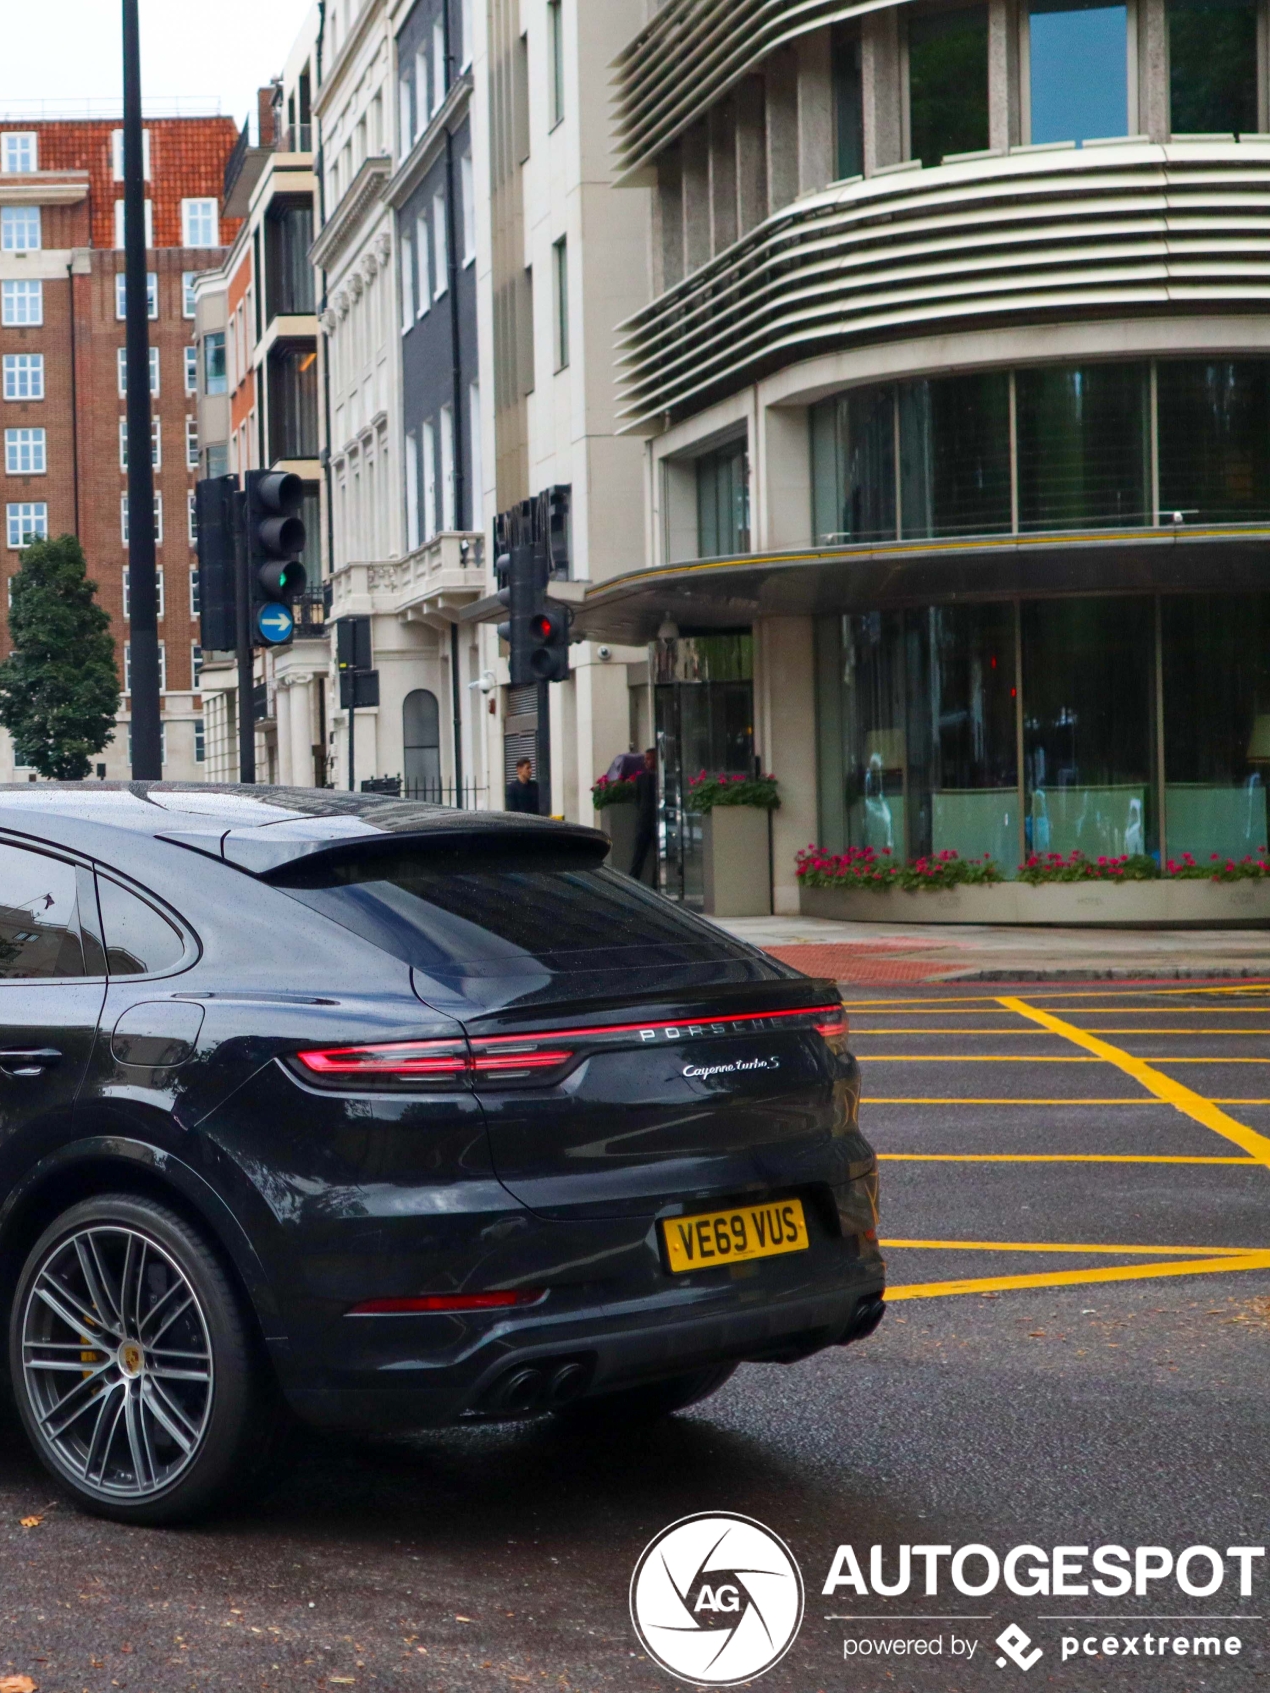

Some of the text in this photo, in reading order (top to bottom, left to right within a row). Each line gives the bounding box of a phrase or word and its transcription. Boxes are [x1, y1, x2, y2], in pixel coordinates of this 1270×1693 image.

[639, 1017, 784, 1042] PORSCHE
[683, 1063, 735, 1080] Cayenne
[767, 1056, 781, 1070] S
[677, 1206, 798, 1261] VE69 VUS
